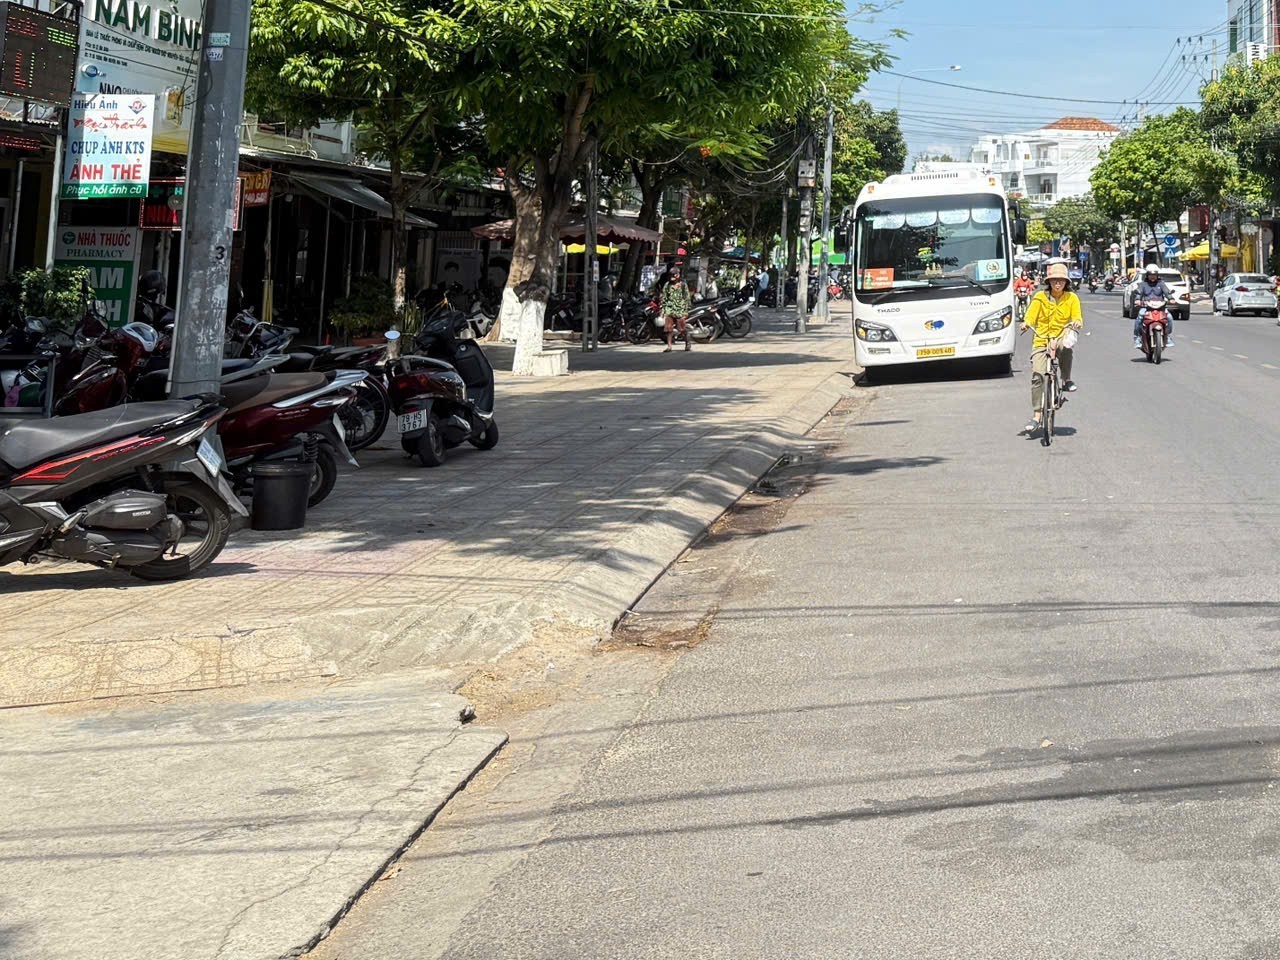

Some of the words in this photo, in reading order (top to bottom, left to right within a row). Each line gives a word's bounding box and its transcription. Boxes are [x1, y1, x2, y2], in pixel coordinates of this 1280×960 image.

[99, 96, 118, 109] Ảnh
[71, 141, 98, 157] CHỤP
[100, 135, 123, 154] ẢNH
[125, 141, 145, 154] KTS
[69, 158, 103, 180] ẢNH
[111, 158, 142, 180] THẺ
[66, 185, 89, 196] Phục
[92, 184, 107, 194] hồi
[109, 184, 127, 194] ảnh
[129, 185, 142, 194] cũ
[77, 230, 96, 246] NHÀ
[100, 227, 131, 247] THUỐC
[67, 248, 125, 258] PHARMACY
[215, 246, 225, 260] 3
[402, 420, 422, 431] 3767
